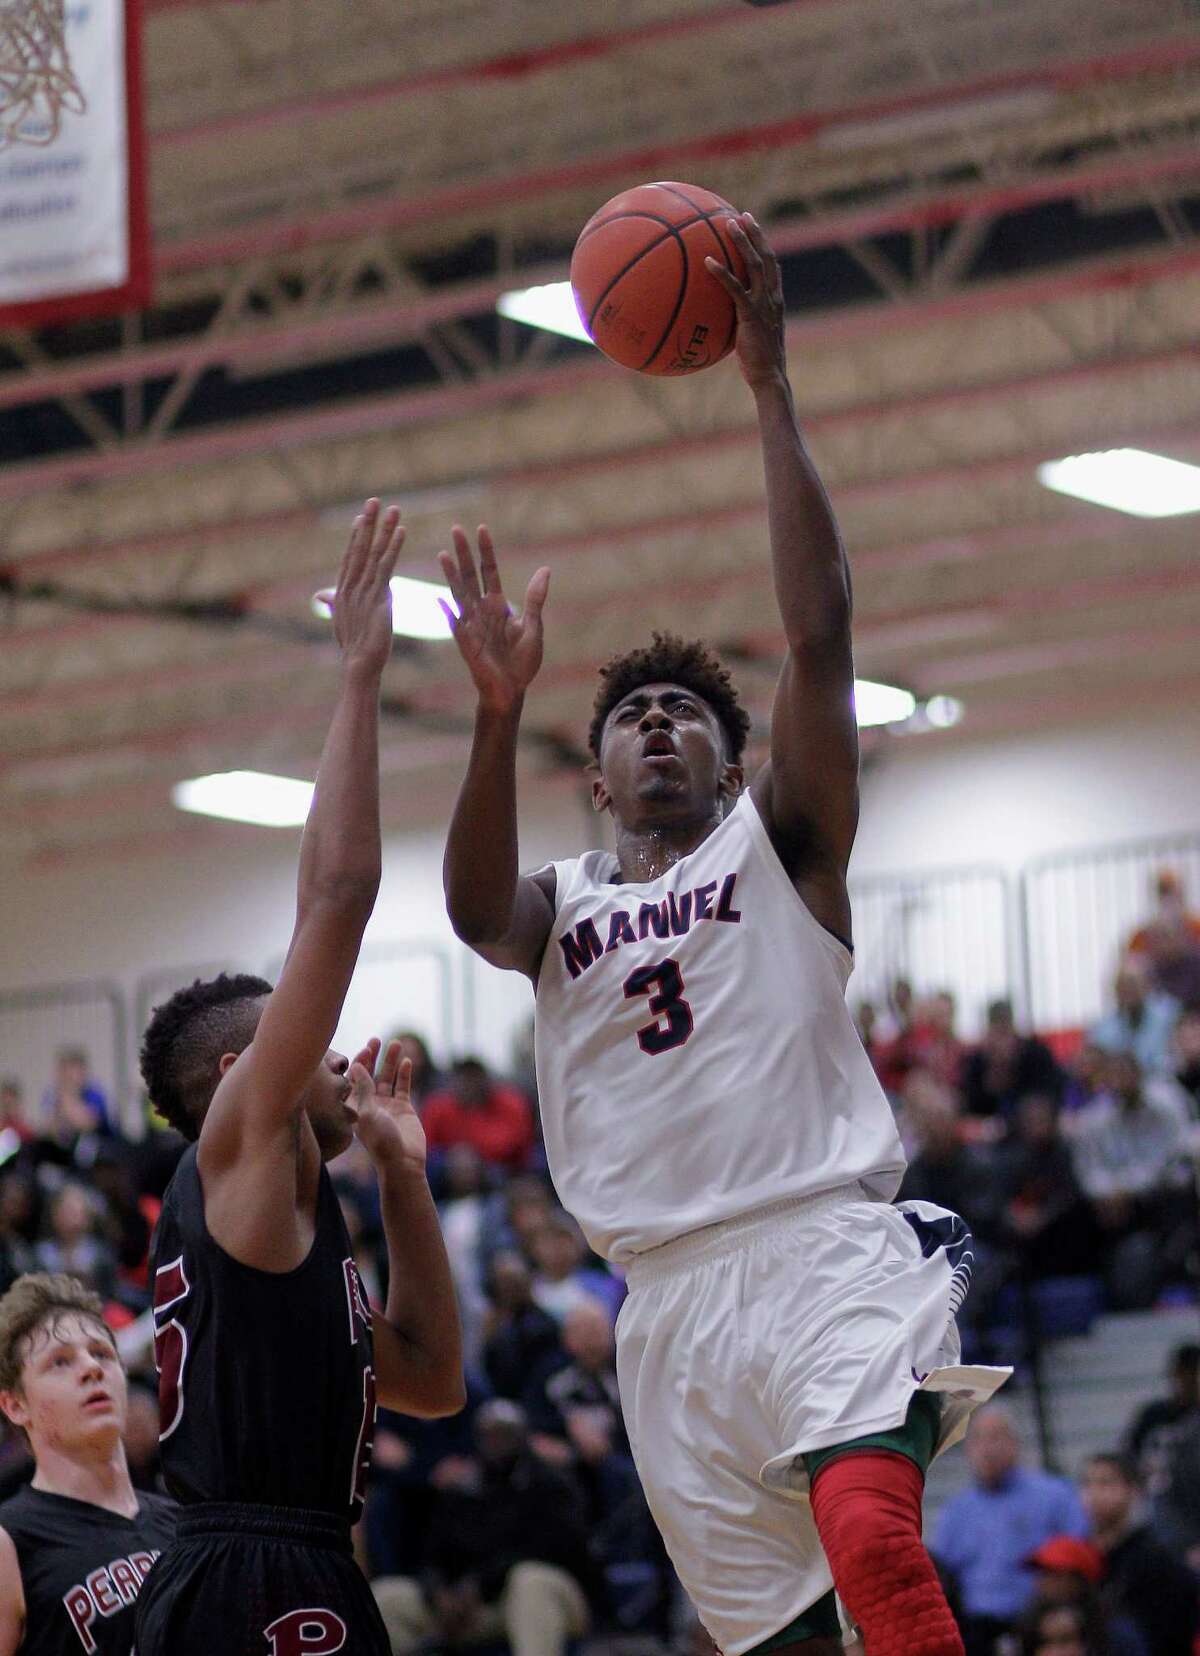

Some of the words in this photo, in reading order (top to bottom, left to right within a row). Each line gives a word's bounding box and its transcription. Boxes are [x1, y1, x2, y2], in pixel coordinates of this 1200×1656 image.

[558, 873, 741, 980] MANVEL
[622, 957, 694, 1056] 3
[62, 1549, 161, 1655] PEAR
[262, 1607, 347, 1656] P
